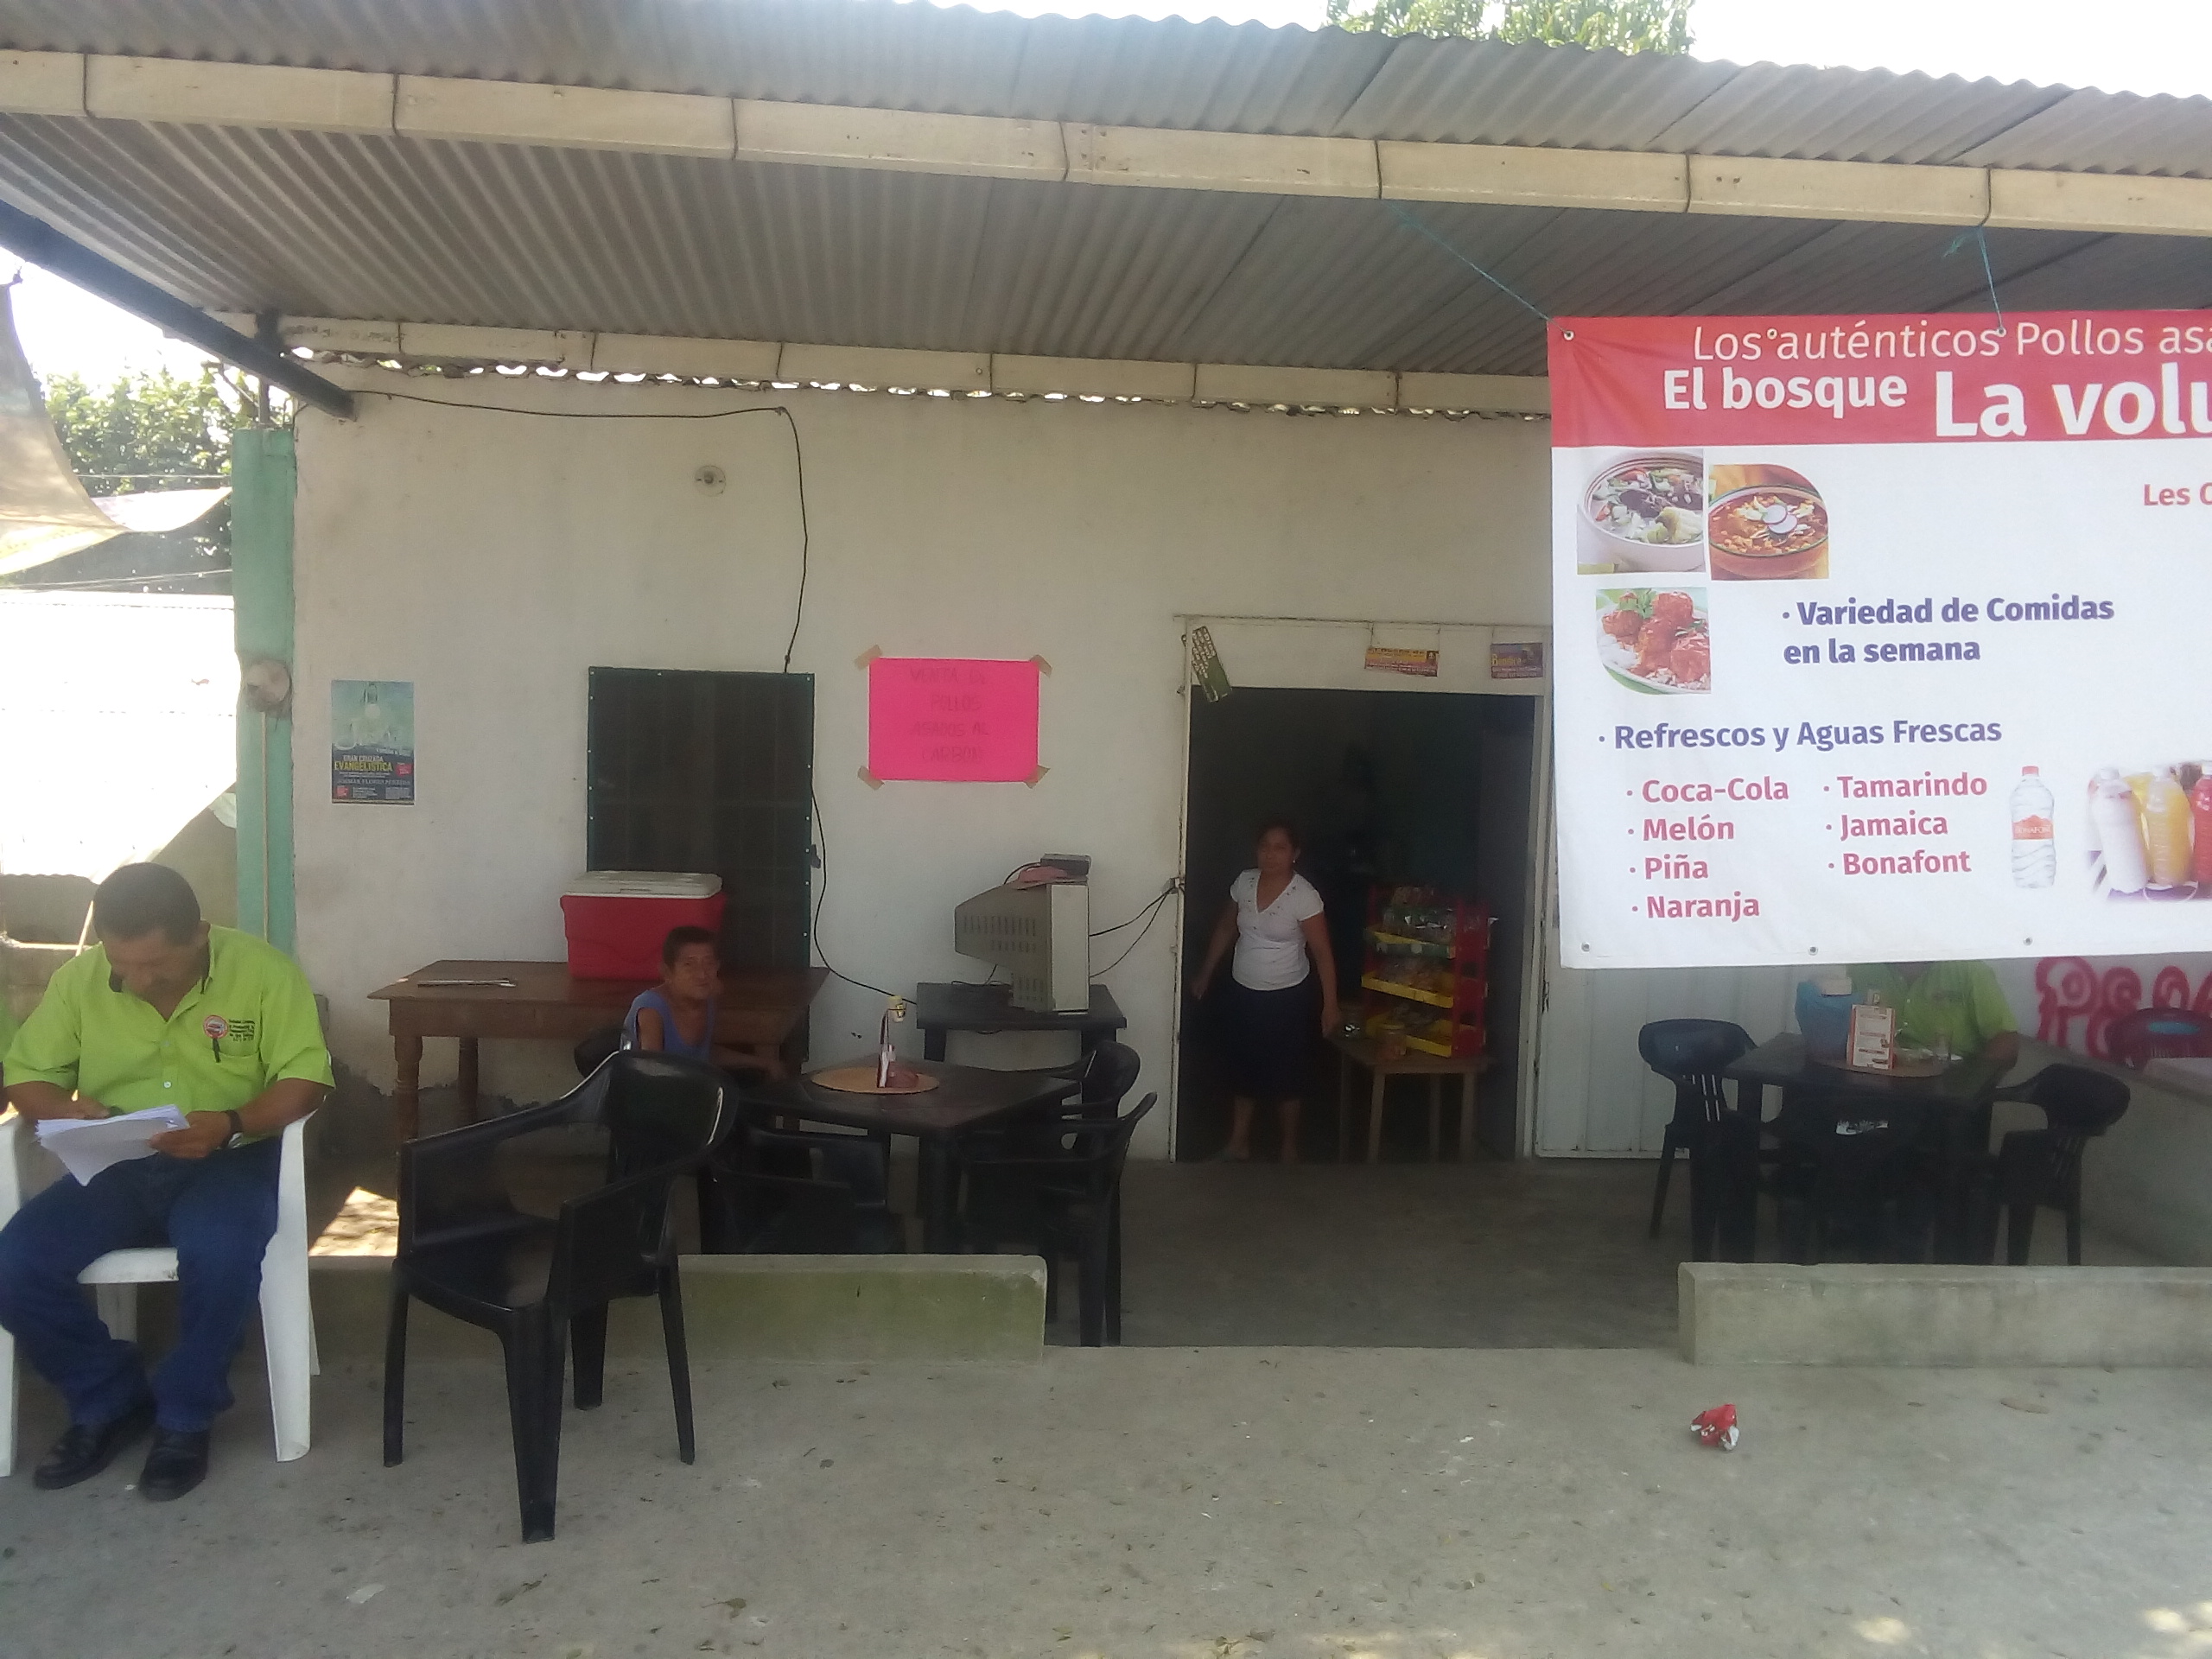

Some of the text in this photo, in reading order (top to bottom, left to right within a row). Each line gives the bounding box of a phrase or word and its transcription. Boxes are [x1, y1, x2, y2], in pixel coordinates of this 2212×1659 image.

[1694, 327, 1762, 361] Los
[1779, 321, 2000, 359] auténticos
[2018, 321, 2144, 357] Pollos
[1664, 366, 1908, 419] El bosque
[1936, 371, 2028, 438] La
[2144, 484, 2191, 506] Les
[1797, 594, 2115, 626] Variedad de Comidas
[1783, 639, 1981, 664] en la semana
[930, 693, 982, 712] POLLOS
[1615, 720, 2002, 752] Refrescos y Aguas Frescas
[1642, 775, 1789, 804] Coca-Cola
[1837, 772, 1987, 798] Tamarindo
[1643, 814, 1735, 842] Melón
[1840, 810, 1948, 839] Jamaica
[1644, 854, 1709, 880] Piña
[1843, 849, 1972, 875] Bonafont
[1647, 891, 1760, 923] Naranja
